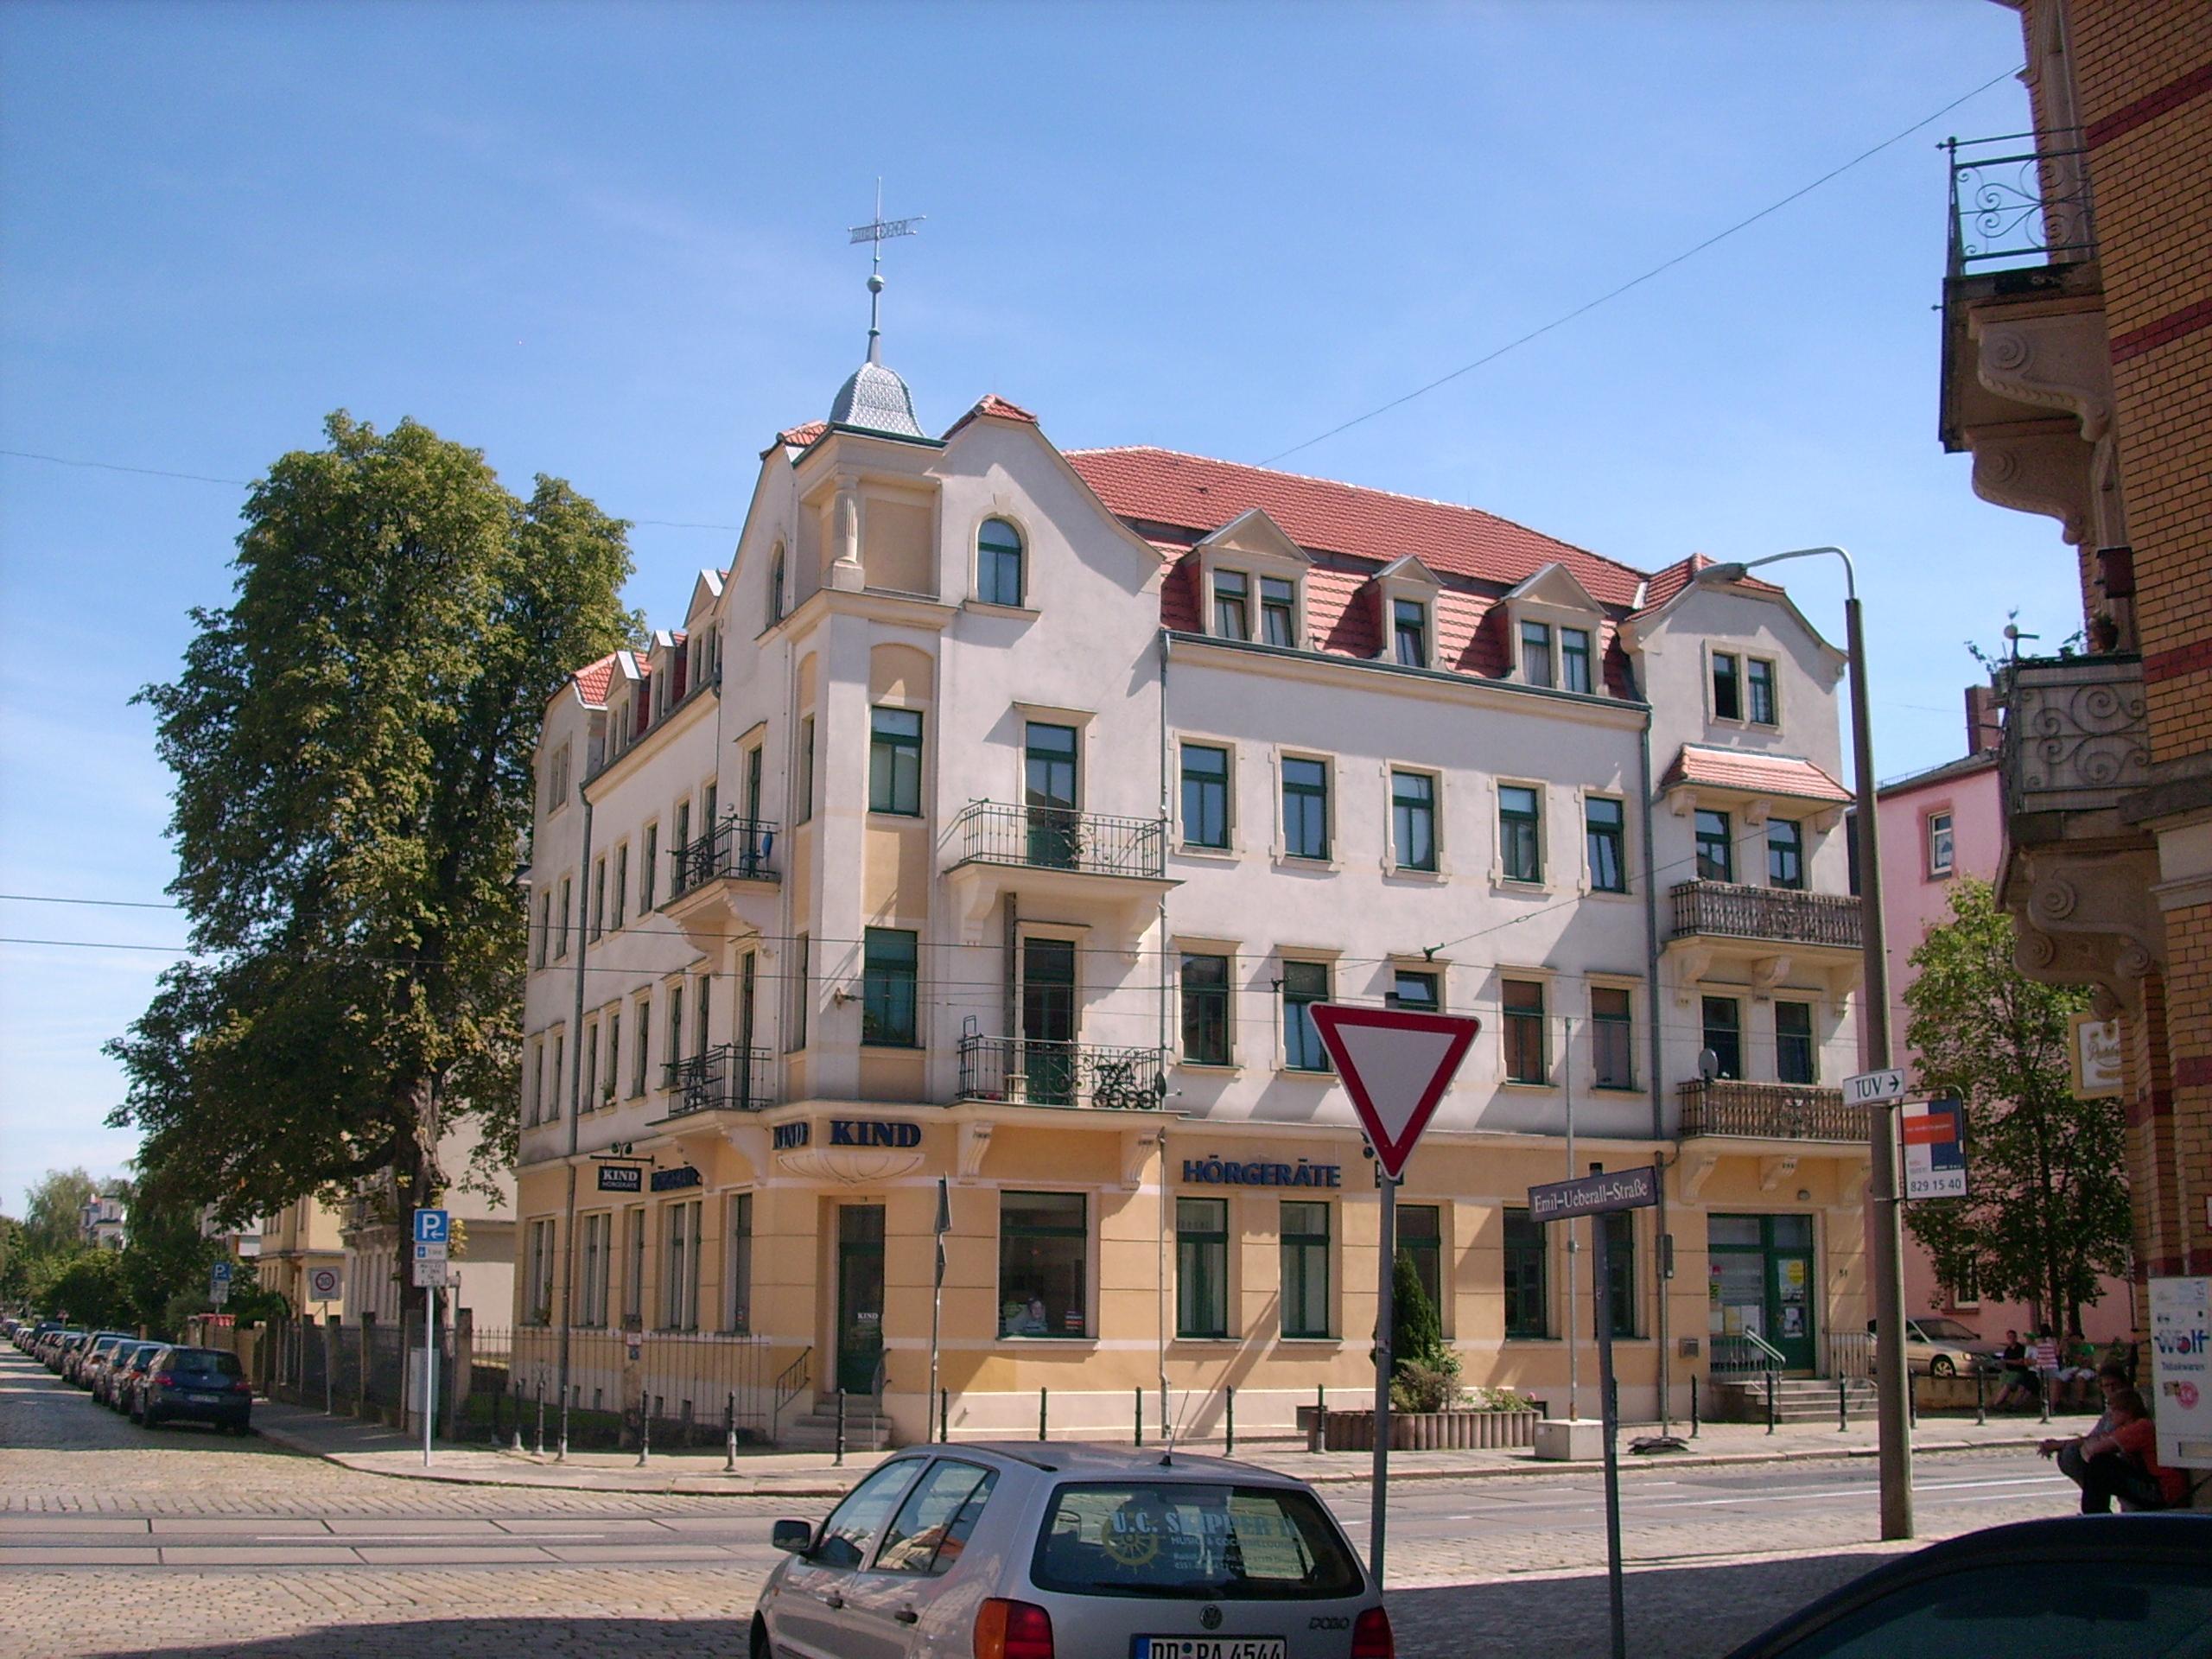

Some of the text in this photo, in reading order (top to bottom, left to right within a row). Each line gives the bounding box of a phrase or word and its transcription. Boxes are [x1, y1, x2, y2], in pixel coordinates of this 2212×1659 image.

[830, 1120, 921, 1147] KIND
[602, 1169, 638, 1181] KIND
[1183, 1154, 1341, 1188] HÖRGERÄTE
[1535, 1178, 1649, 1213] Emil-Ueberall-Straße
[1910, 1179, 1961, 1192] 829 15 40
[422, 1213, 441, 1239] P
